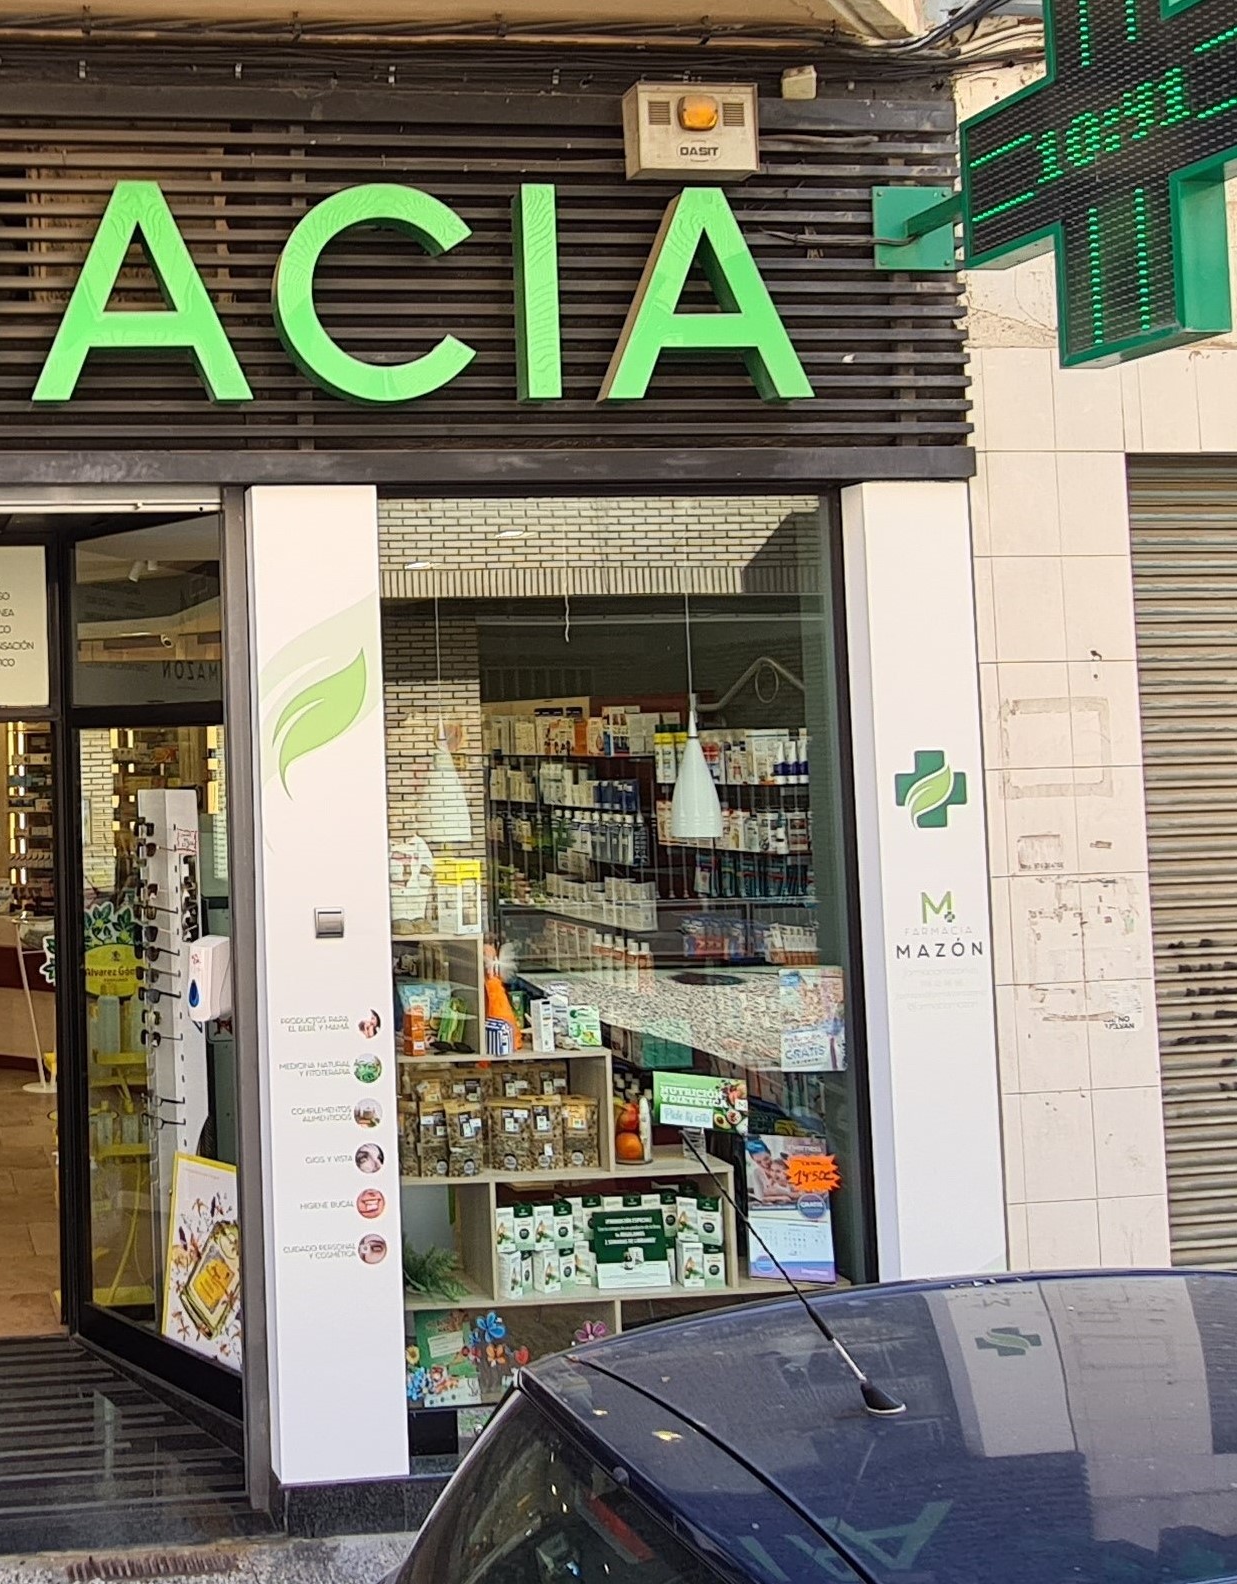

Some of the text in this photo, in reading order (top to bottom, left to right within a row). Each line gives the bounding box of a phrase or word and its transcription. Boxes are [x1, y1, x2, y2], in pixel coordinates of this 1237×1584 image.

[904, 926, 972, 936] FARMACIA
[896, 938, 983, 959] MAZÓN
[280, 1016, 327, 1025] PRODUCTOS
[785, 1045, 825, 1060] GRATIS
[279, 1060, 350, 1070] MEDICINA NATURAL
[660, 1085, 726, 1101] NUTRICIÓN
[291, 1105, 352, 1115] COMPLEMENTOS
[333, 1154, 353, 1163] VISTA
[300, 1200, 354, 1210] HIGIENE BUCAL
